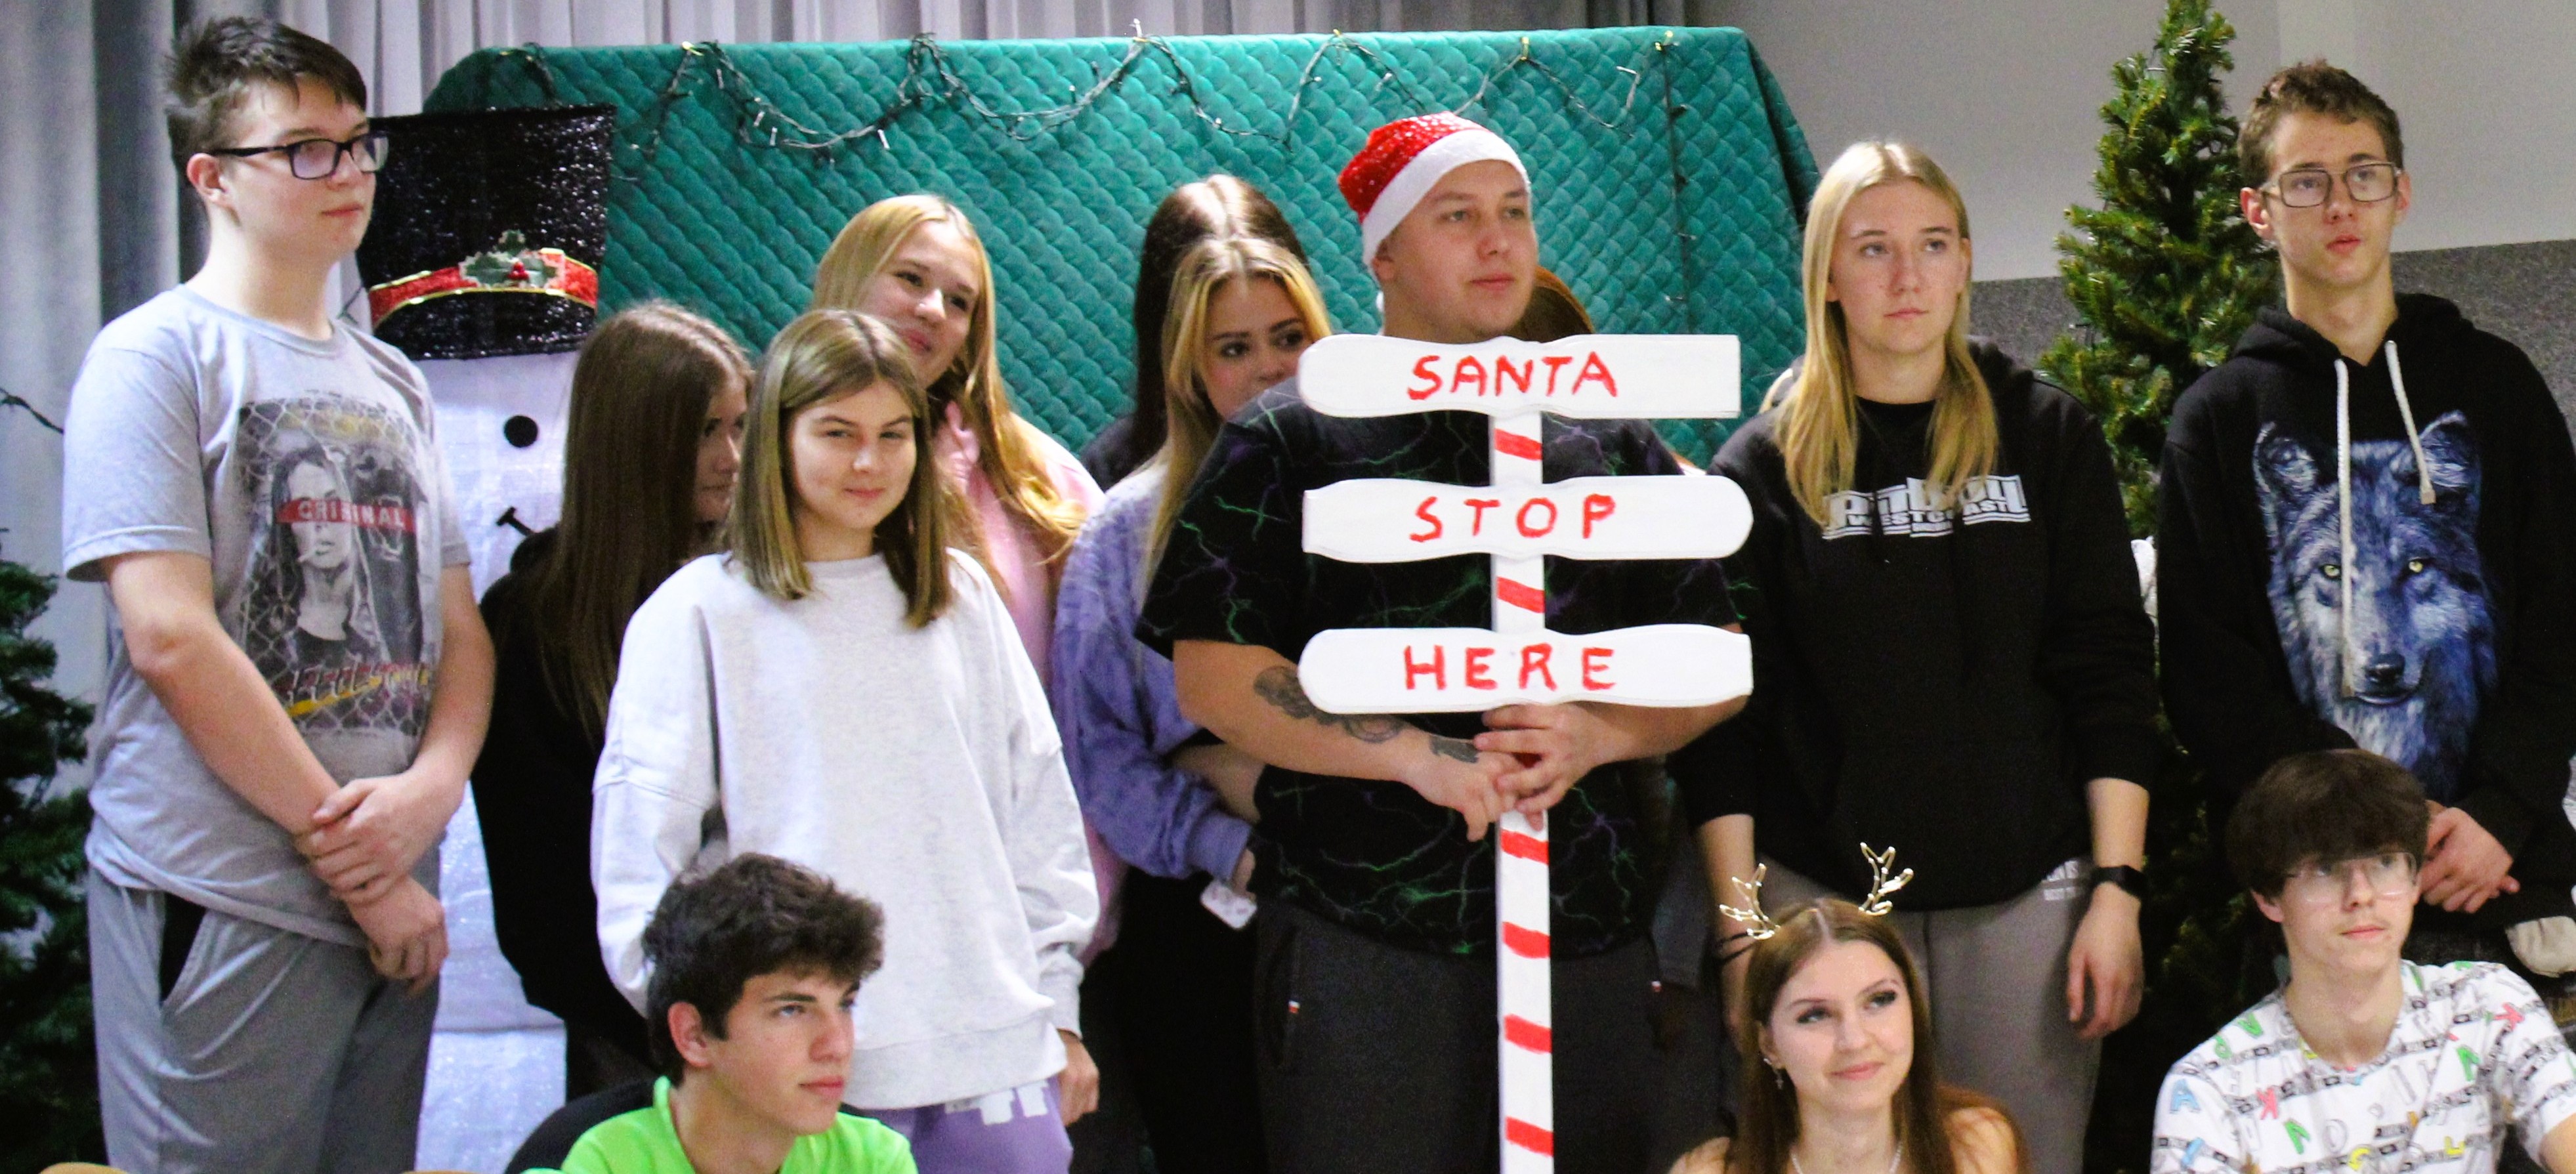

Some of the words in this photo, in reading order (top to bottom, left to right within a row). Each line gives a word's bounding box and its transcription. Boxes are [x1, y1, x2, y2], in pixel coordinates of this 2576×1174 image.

[1408, 352, 1617, 400] SANTA
[1410, 493, 1616, 543] STOP
[1404, 643, 1615, 691] HERE
